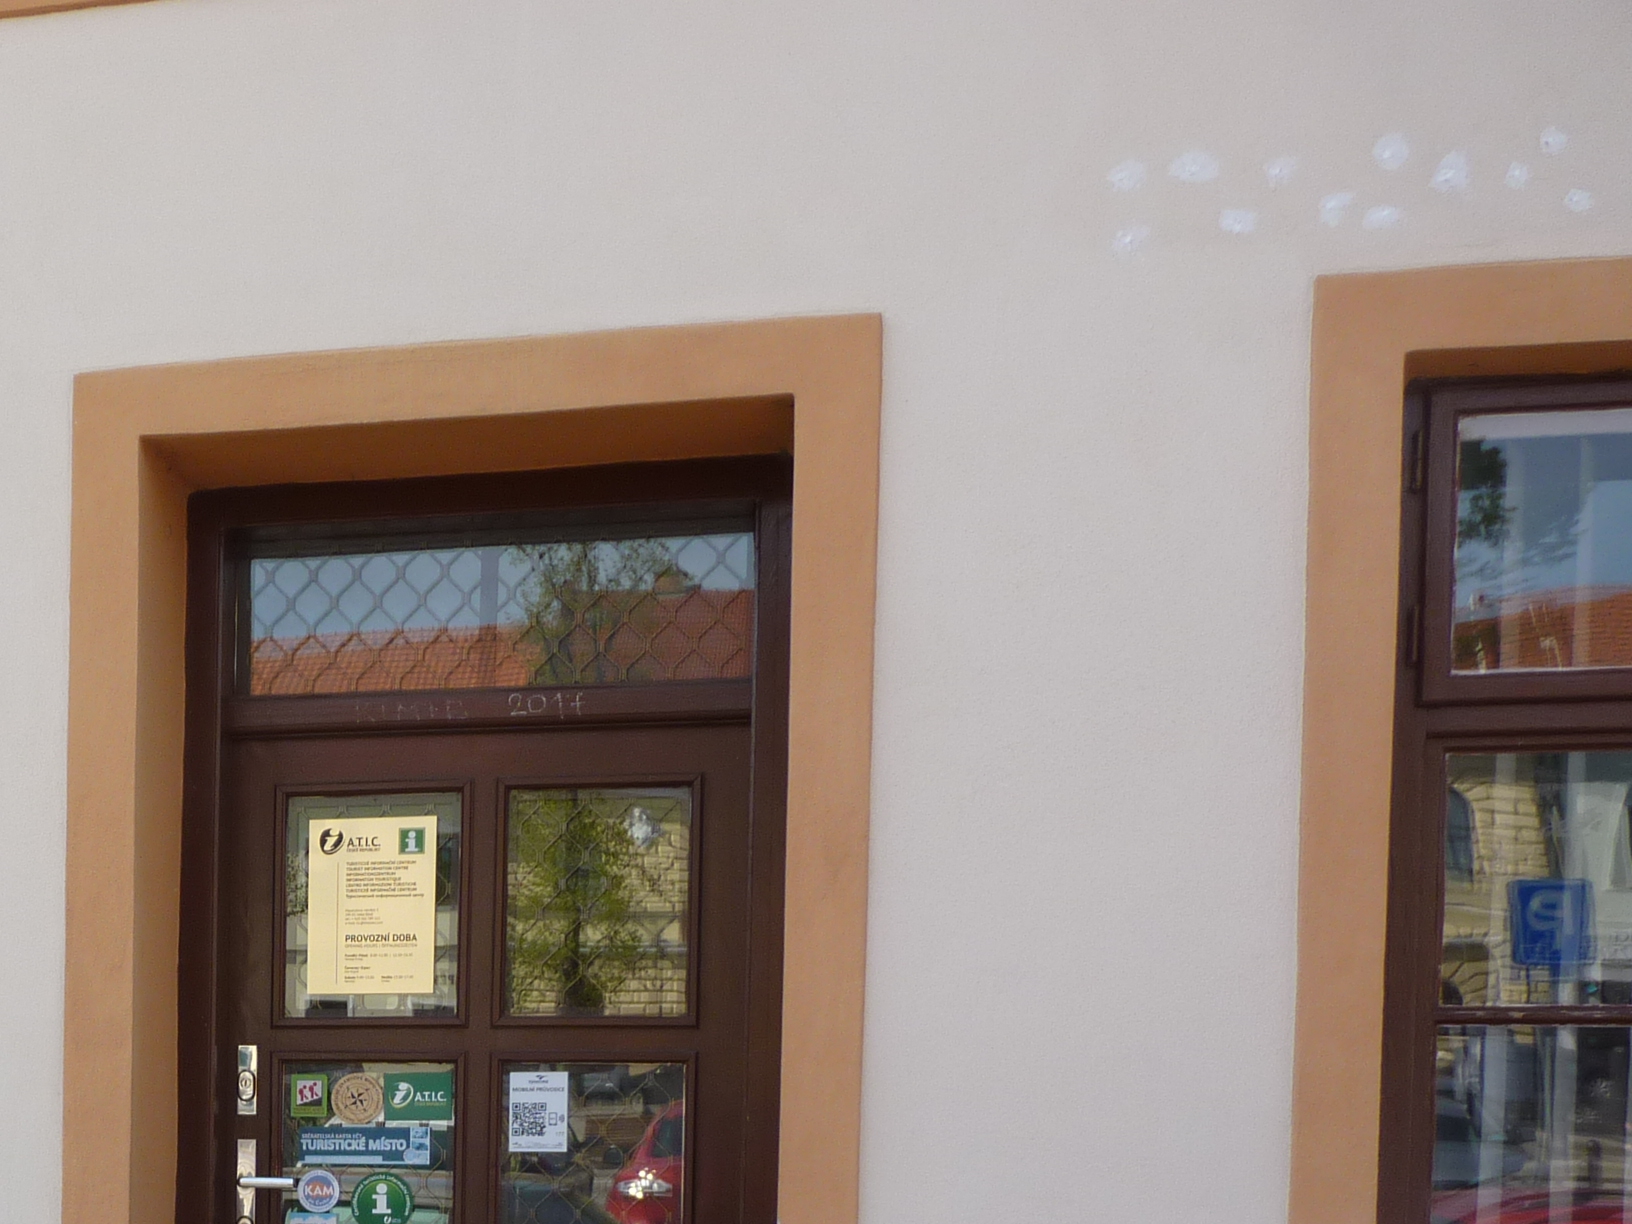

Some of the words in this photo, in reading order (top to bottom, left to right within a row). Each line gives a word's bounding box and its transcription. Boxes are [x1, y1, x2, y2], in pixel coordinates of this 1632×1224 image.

[508, 692, 585, 719] 2017
[347, 836, 381, 848] A.T.I.C.
[345, 932, 390, 943] PROVOZNÍ
[392, 933, 418, 942] DOBA
[414, 1091, 447, 1102] A.T.I.C.
[301, 1136, 366, 1151] TURISTICKÉ
[369, 1137, 407, 1151] MÍSTO
[304, 1185, 334, 1196] KAM
